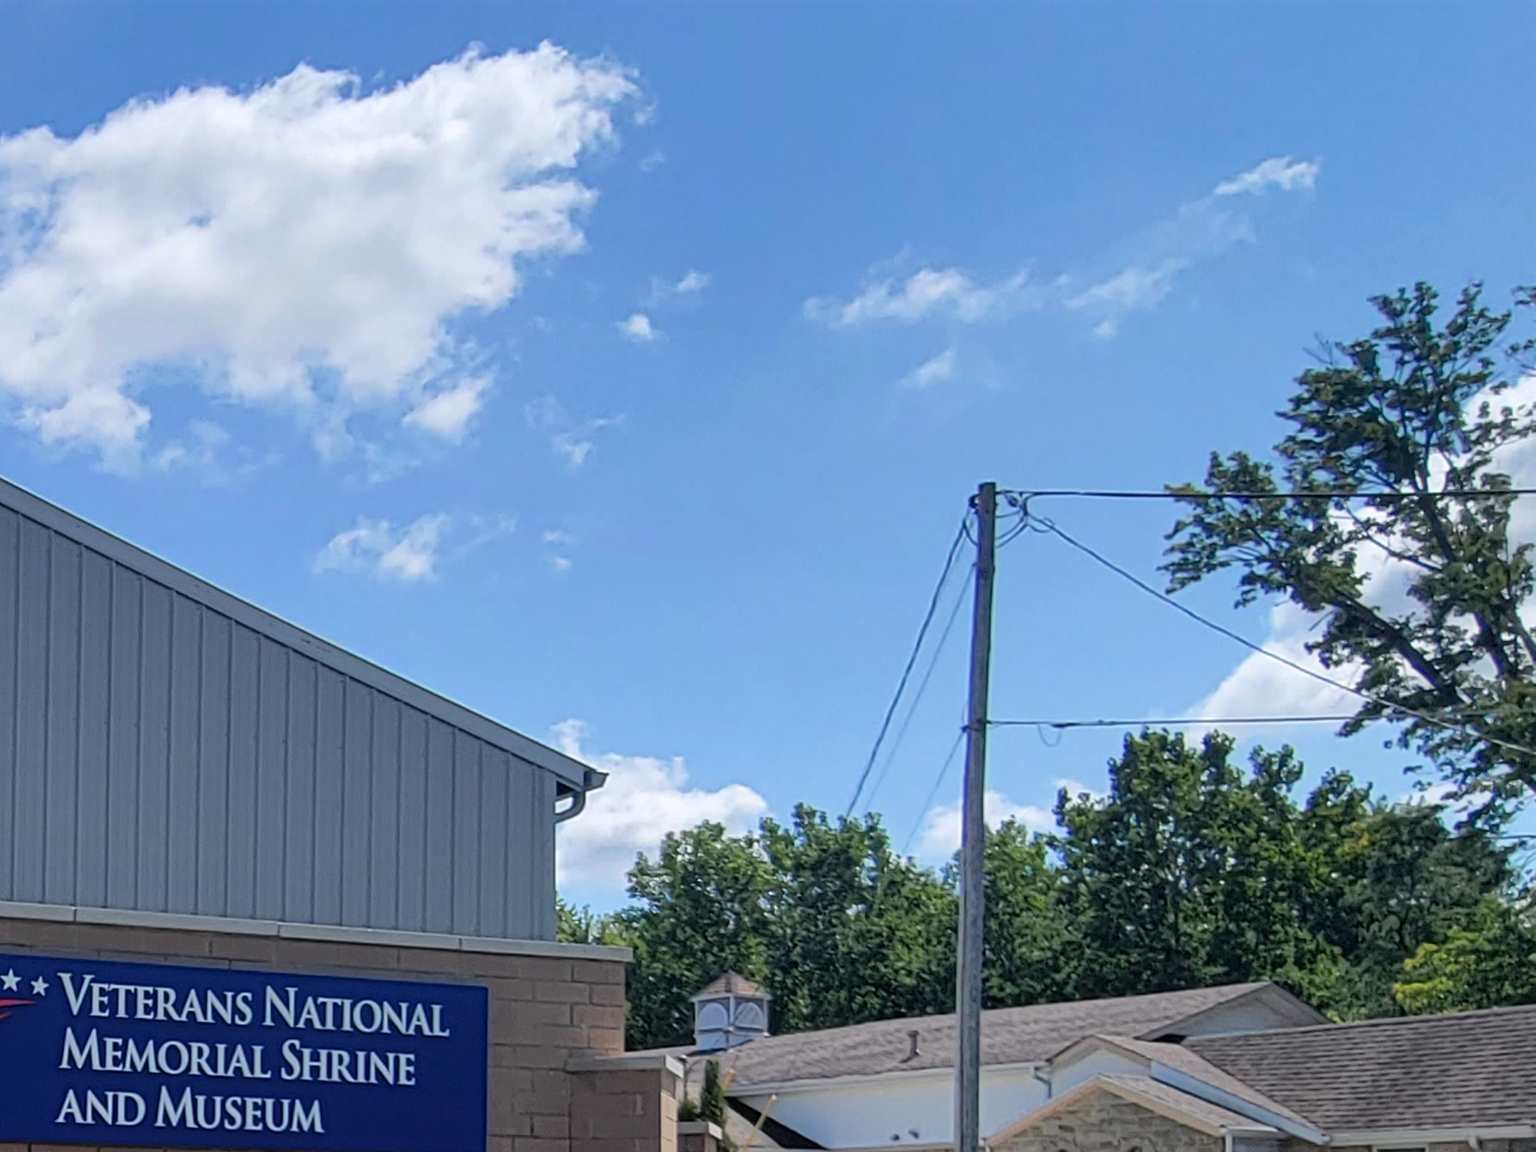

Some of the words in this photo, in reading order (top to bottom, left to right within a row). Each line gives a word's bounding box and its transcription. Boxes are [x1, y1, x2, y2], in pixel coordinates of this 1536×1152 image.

[56, 972, 254, 1027] VETERANS
[263, 985, 451, 1038] NATIONAL
[58, 1027, 271, 1079] MEMORIAL
[280, 1039, 416, 1086] SHRINE
[55, 1089, 146, 1126] AND
[154, 1085, 325, 1134] MUSEUM
